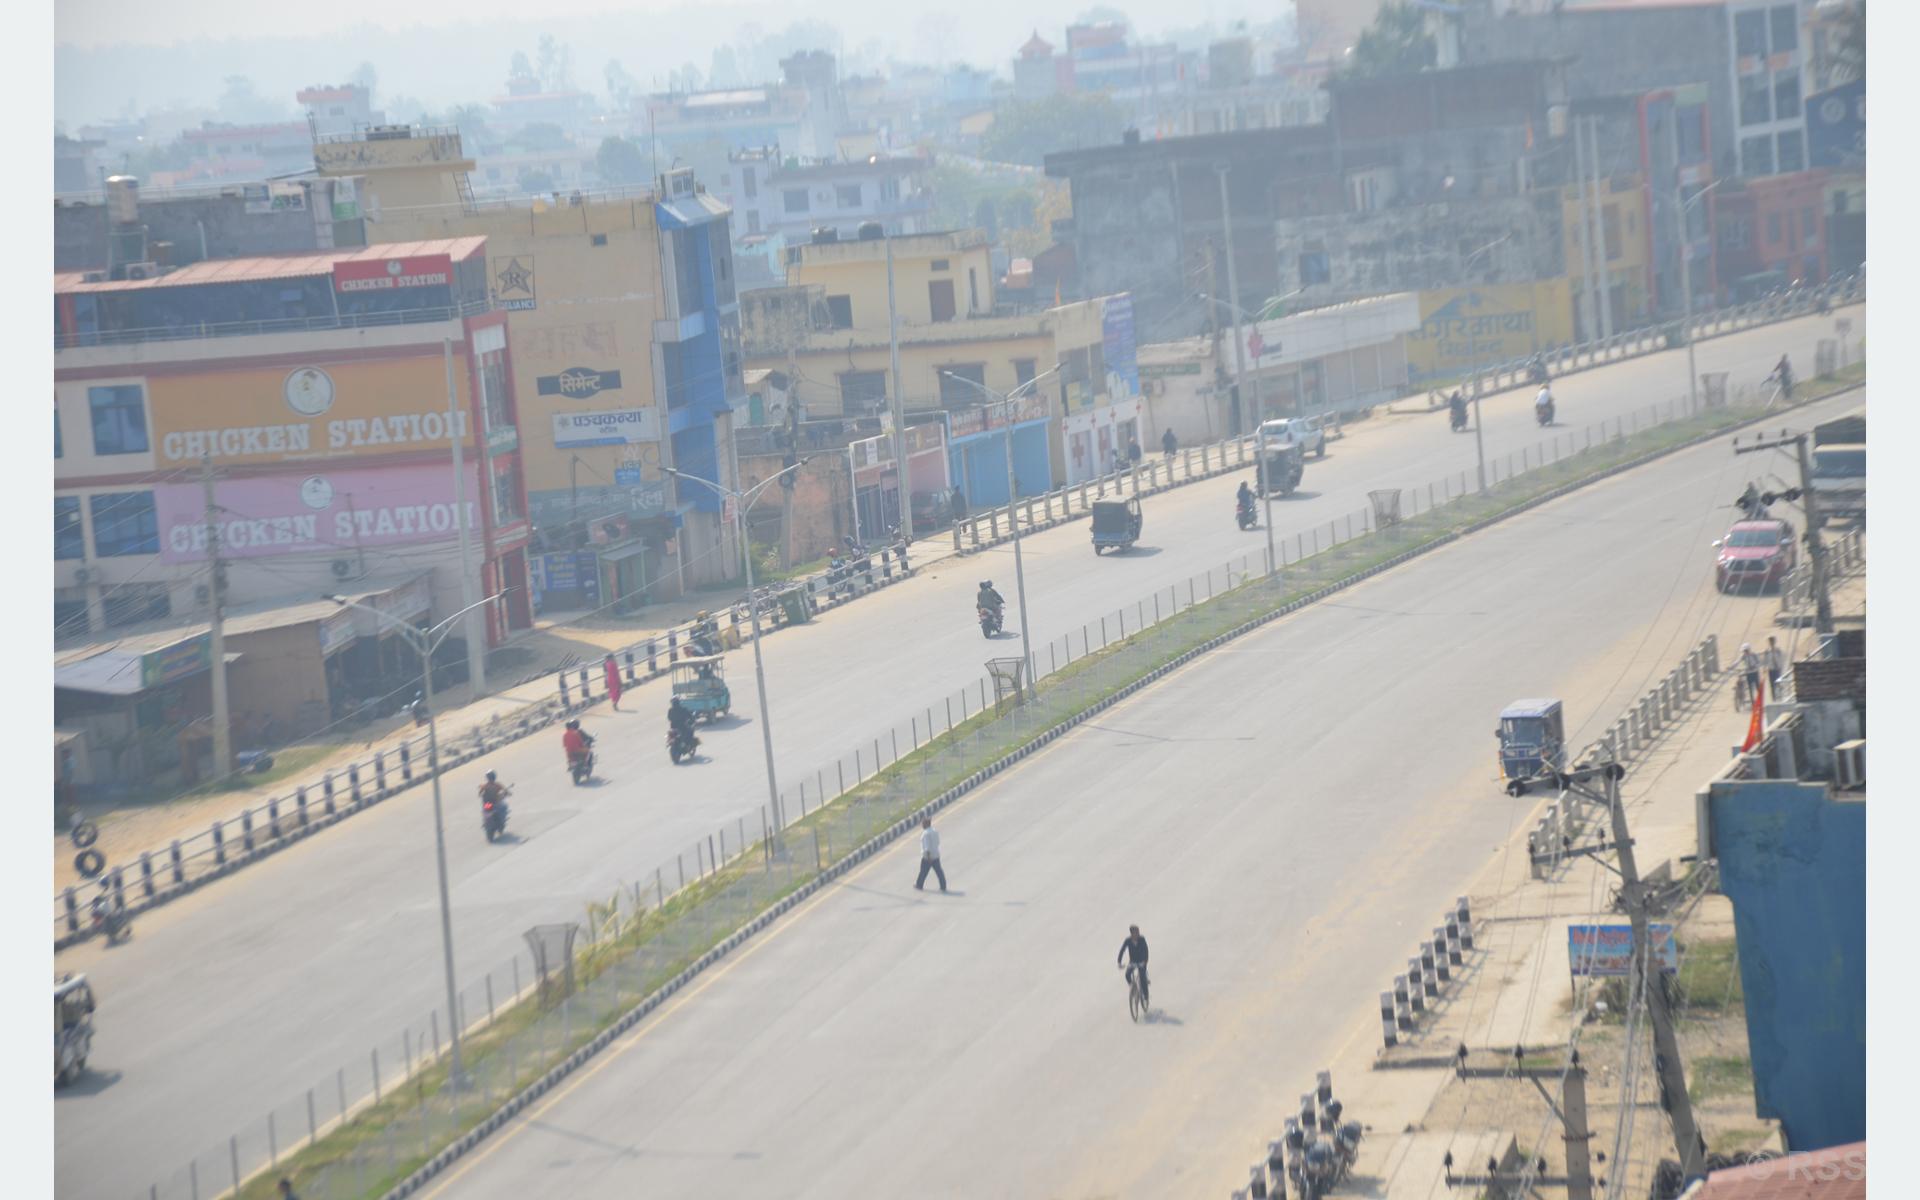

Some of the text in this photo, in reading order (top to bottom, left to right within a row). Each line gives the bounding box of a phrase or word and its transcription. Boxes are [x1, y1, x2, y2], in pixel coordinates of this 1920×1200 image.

[341, 272, 447, 292] CHICKEN STATION
[558, 371, 601, 394] सिमेन्ट
[163, 423, 311, 461] CHICKEN
[327, 410, 467, 448] STATION
[169, 502, 474, 553] CHICKEN STATION
